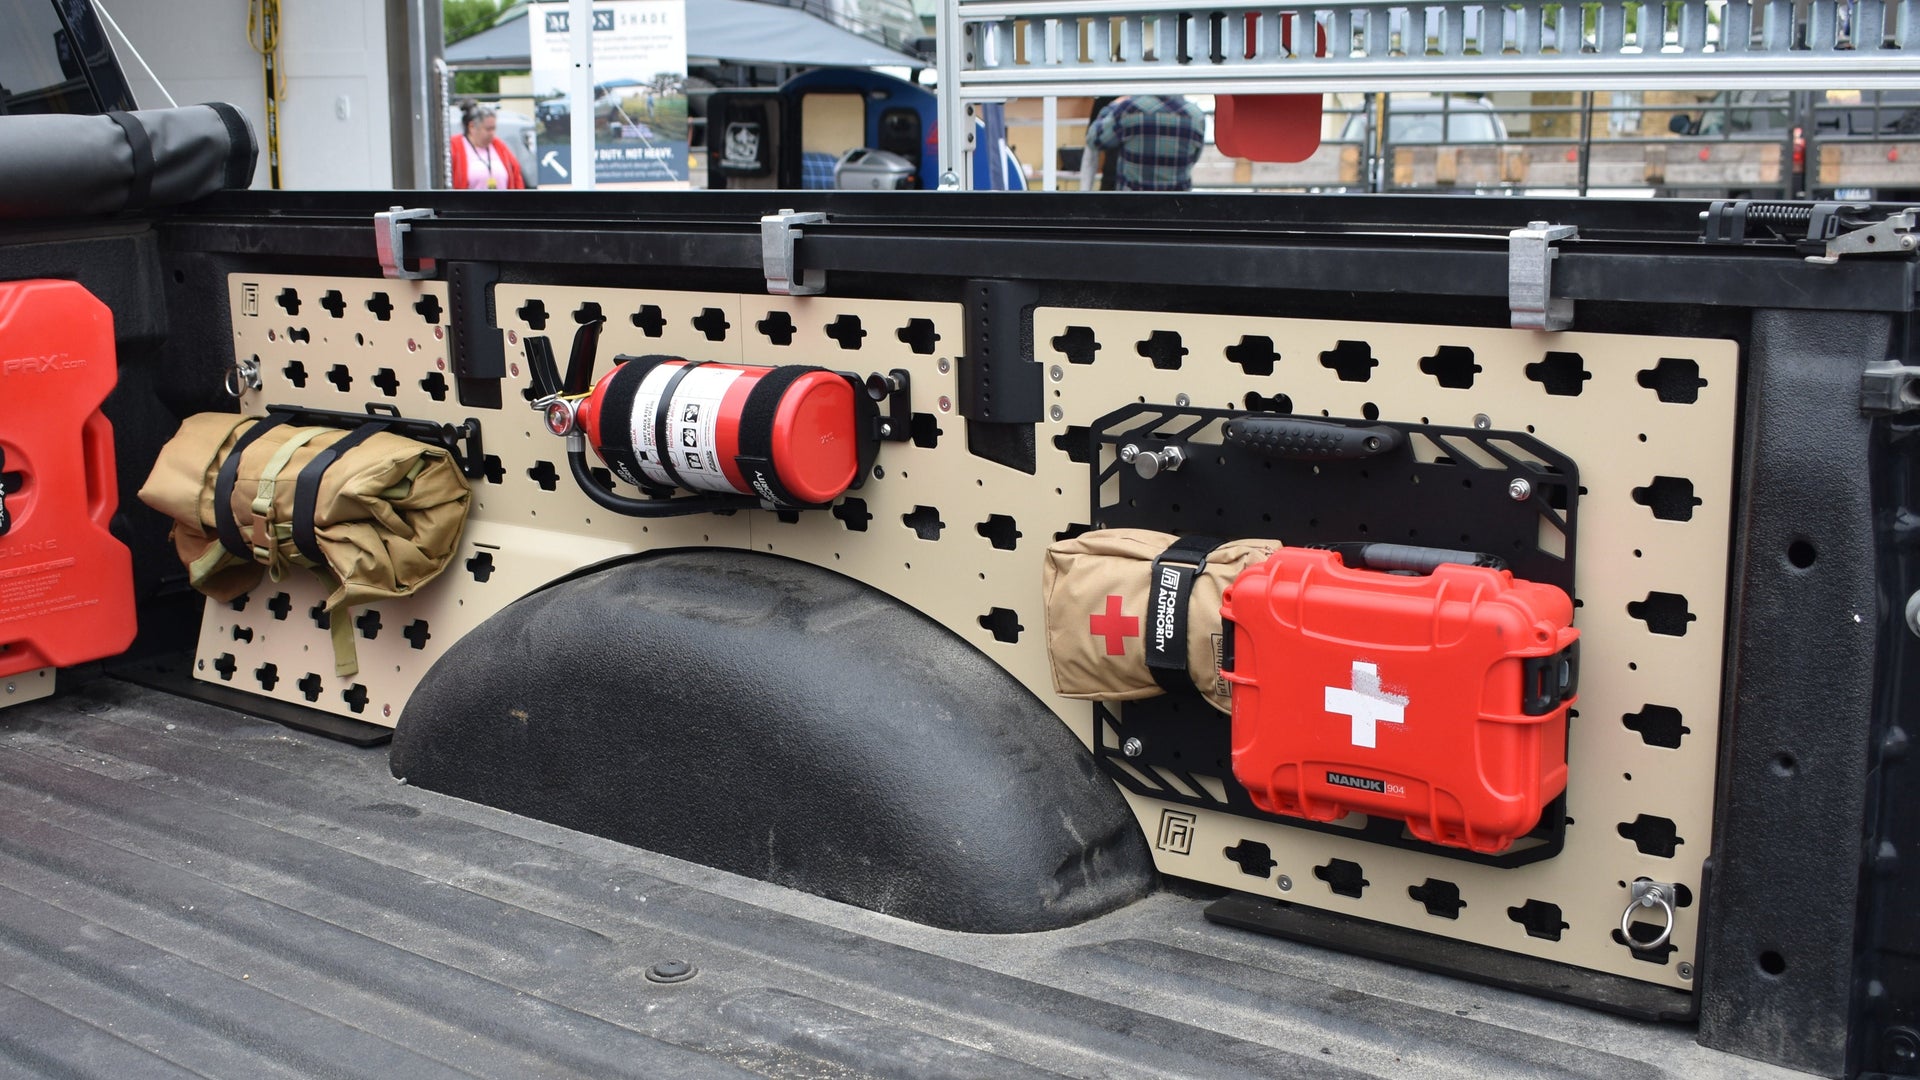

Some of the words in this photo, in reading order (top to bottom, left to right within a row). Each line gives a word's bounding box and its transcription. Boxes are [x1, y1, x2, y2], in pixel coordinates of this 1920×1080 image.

[549, 12, 612, 30] MN
[620, 12, 667, 26] SHADE
[1155, 587, 1168, 653] AUTHORITY
[1164, 590, 1177, 639] FORGED
[1328, 773, 1382, 792] NANUK
[1386, 784, 1405, 795] 904
